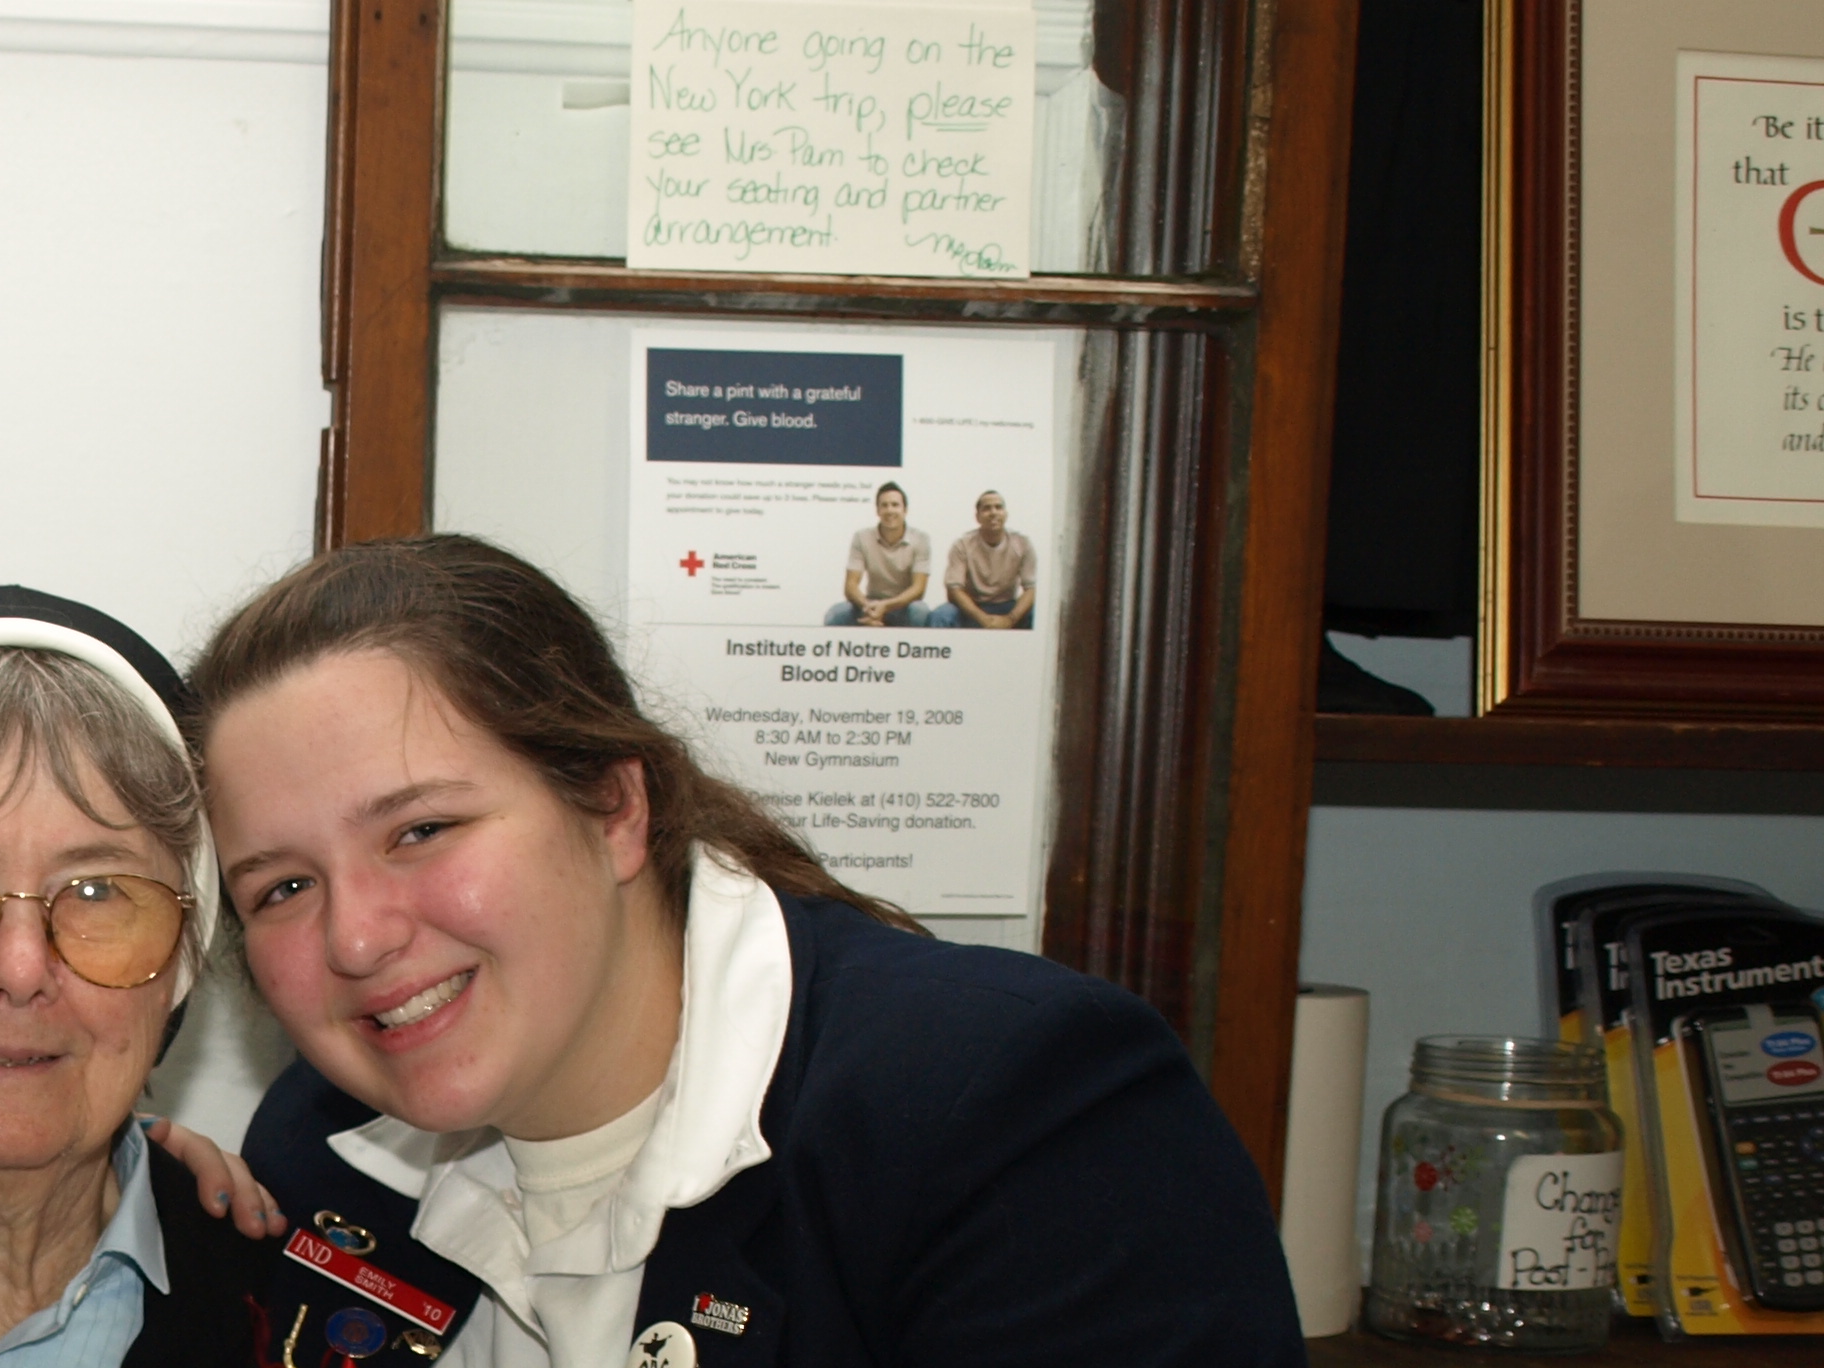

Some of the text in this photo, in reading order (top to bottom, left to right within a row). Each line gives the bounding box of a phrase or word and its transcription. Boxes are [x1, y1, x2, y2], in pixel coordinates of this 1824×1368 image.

[652, 8, 1015, 73] Anyone going on the
[648, 64, 1012, 139] New York trip, please
[1752, 115, 1794, 139] Be
[647, 129, 700, 157] see
[774, 127, 844, 167] Pam
[858, 132, 888, 175] to
[902, 150, 989, 178] check
[1733, 156, 1790, 186] that
[647, 169, 1005, 224] your seating and partner
[1784, 306, 1806, 330] is
[1770, 346, 1815, 372] He
[665, 380, 861, 404] Share a pint with a grateful
[1783, 386, 1808, 411] its
[665, 410, 817, 429] stranger. Give blood.
[1782, 430, 1824, 452] and
[726, 639, 952, 658] Institute of Notre Dame
[781, 665, 895, 683] Blood Drive
[706, 707, 963, 726] Wednesday, November 19, 2008
[755, 731, 912, 745] 8:30 AM to 2:30 PM
[765, 752, 899, 770] New Gymnasium
[808, 792, 856, 807] Kielek
[861, 793, 875, 807] at
[881, 793, 921, 810] (410)
[926, 793, 1000, 808] 522-7800
[813, 813, 900, 832] Life-Saving
[906, 814, 976, 829] donation.
[819, 853, 913, 870] Participants!
[1650, 947, 1732, 975] Texas
[1564, 1216, 1605, 1252] for
[295, 1236, 332, 1265] IND
[355, 1274, 394, 1300] SMITH
[358, 1266, 396, 1290] EMILY
[691, 1313, 740, 1334] BROTHERS
[705, 1301, 745, 1323] JONAS
